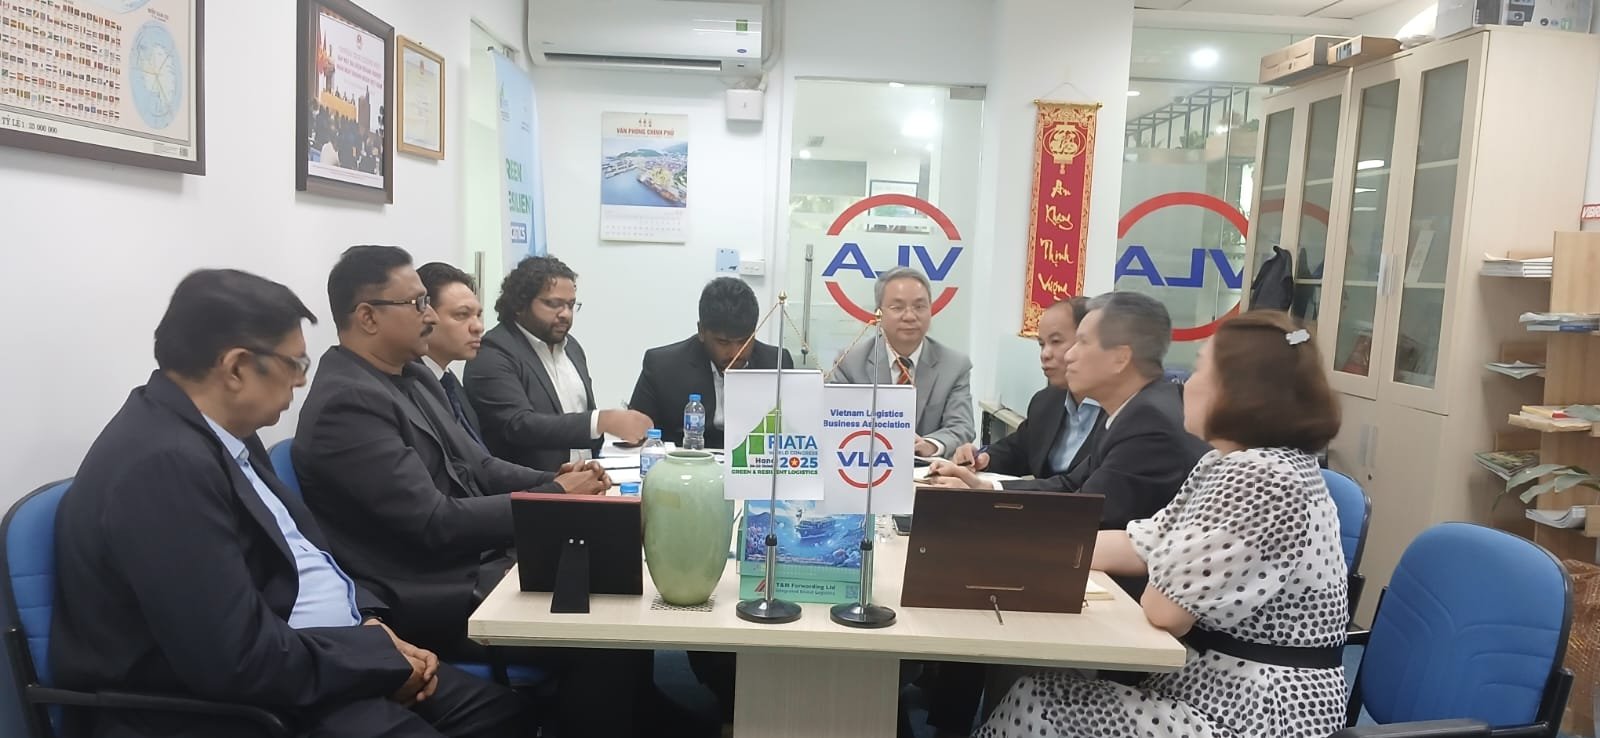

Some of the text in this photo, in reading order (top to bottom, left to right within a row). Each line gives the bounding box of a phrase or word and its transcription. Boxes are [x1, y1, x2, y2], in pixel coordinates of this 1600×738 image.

[830, 409, 904, 419] Vietnam Lgistics
[768, 435, 818, 450] FIATA
[836, 452, 894, 468] VLA
